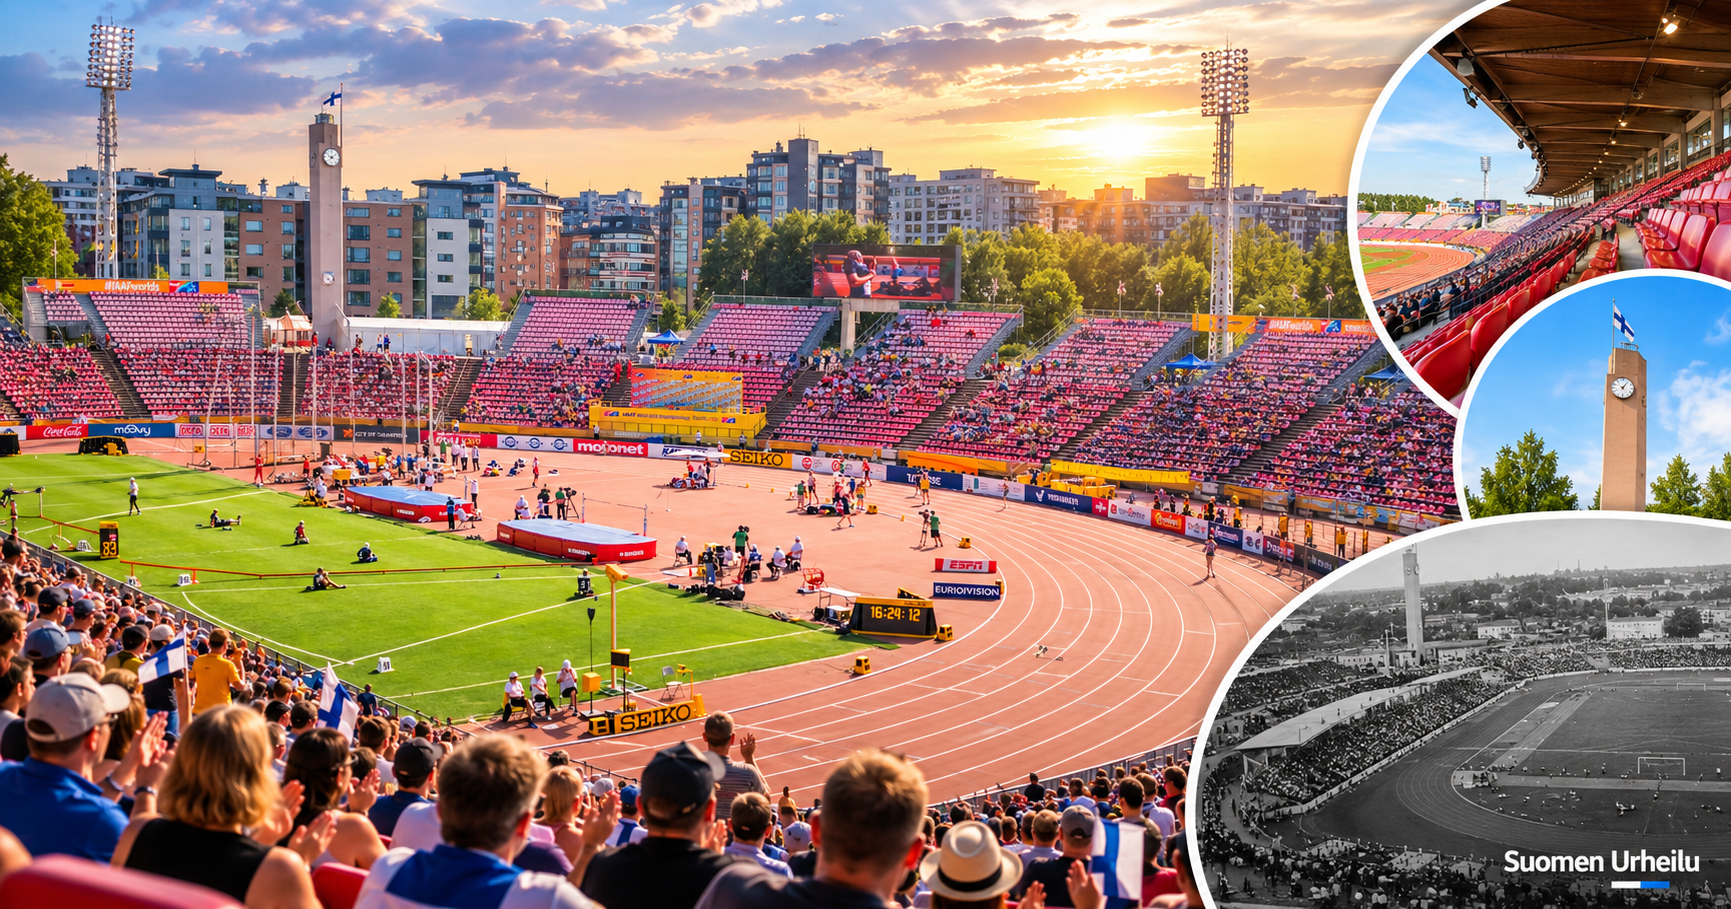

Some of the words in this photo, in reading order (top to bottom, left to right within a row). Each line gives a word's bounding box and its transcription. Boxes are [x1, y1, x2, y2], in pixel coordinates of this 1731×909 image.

[730, 450, 784, 467] SEIKO
[102, 541, 117, 556] 83
[949, 560, 983, 570] ESPN
[620, 704, 692, 732] SEIKO
